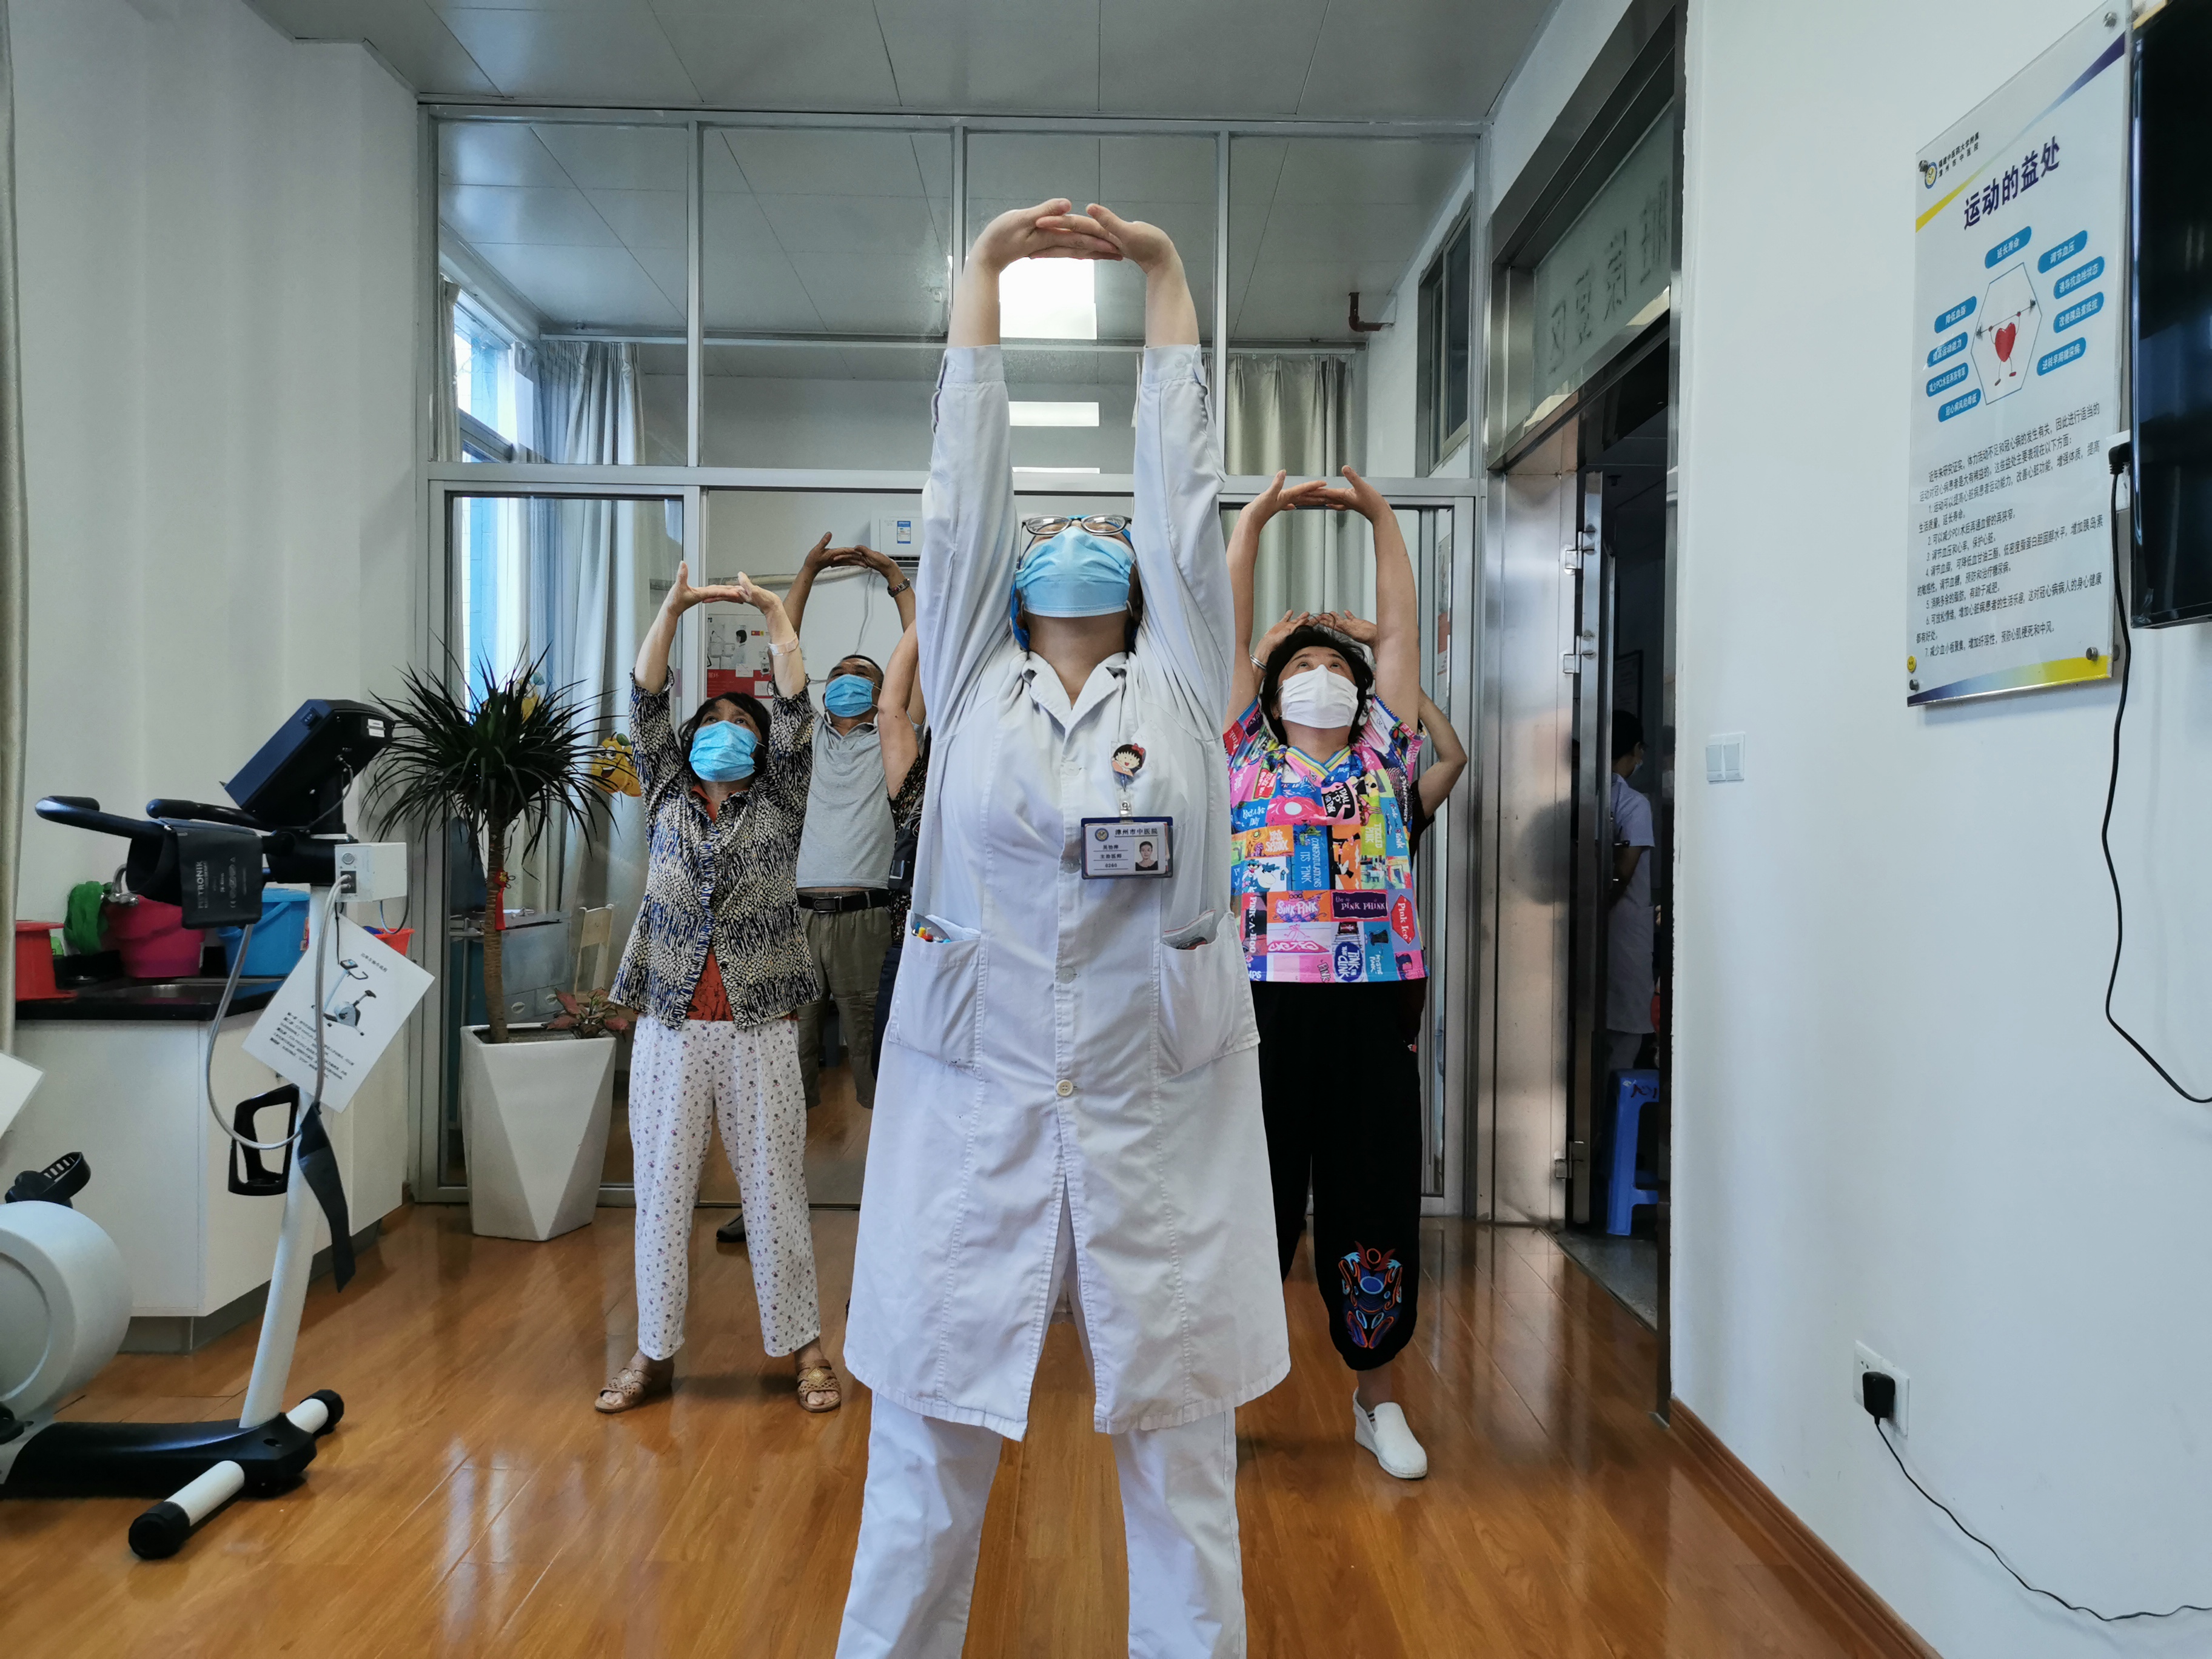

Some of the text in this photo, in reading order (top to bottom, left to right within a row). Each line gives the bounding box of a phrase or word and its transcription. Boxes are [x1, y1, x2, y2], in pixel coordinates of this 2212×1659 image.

[1964, 135, 2060, 230] 运动的益处
[1997, 238, 2020, 259] 延长寿命
[2050, 240, 2075, 264] 调节血压
[1339, 788, 1350, 803] DIAL
[1365, 826, 1374, 843] PINK
[1301, 866, 1312, 883] PINK
[1338, 956, 1350, 978] CLINK
[1347, 950, 1361, 970] PINK
